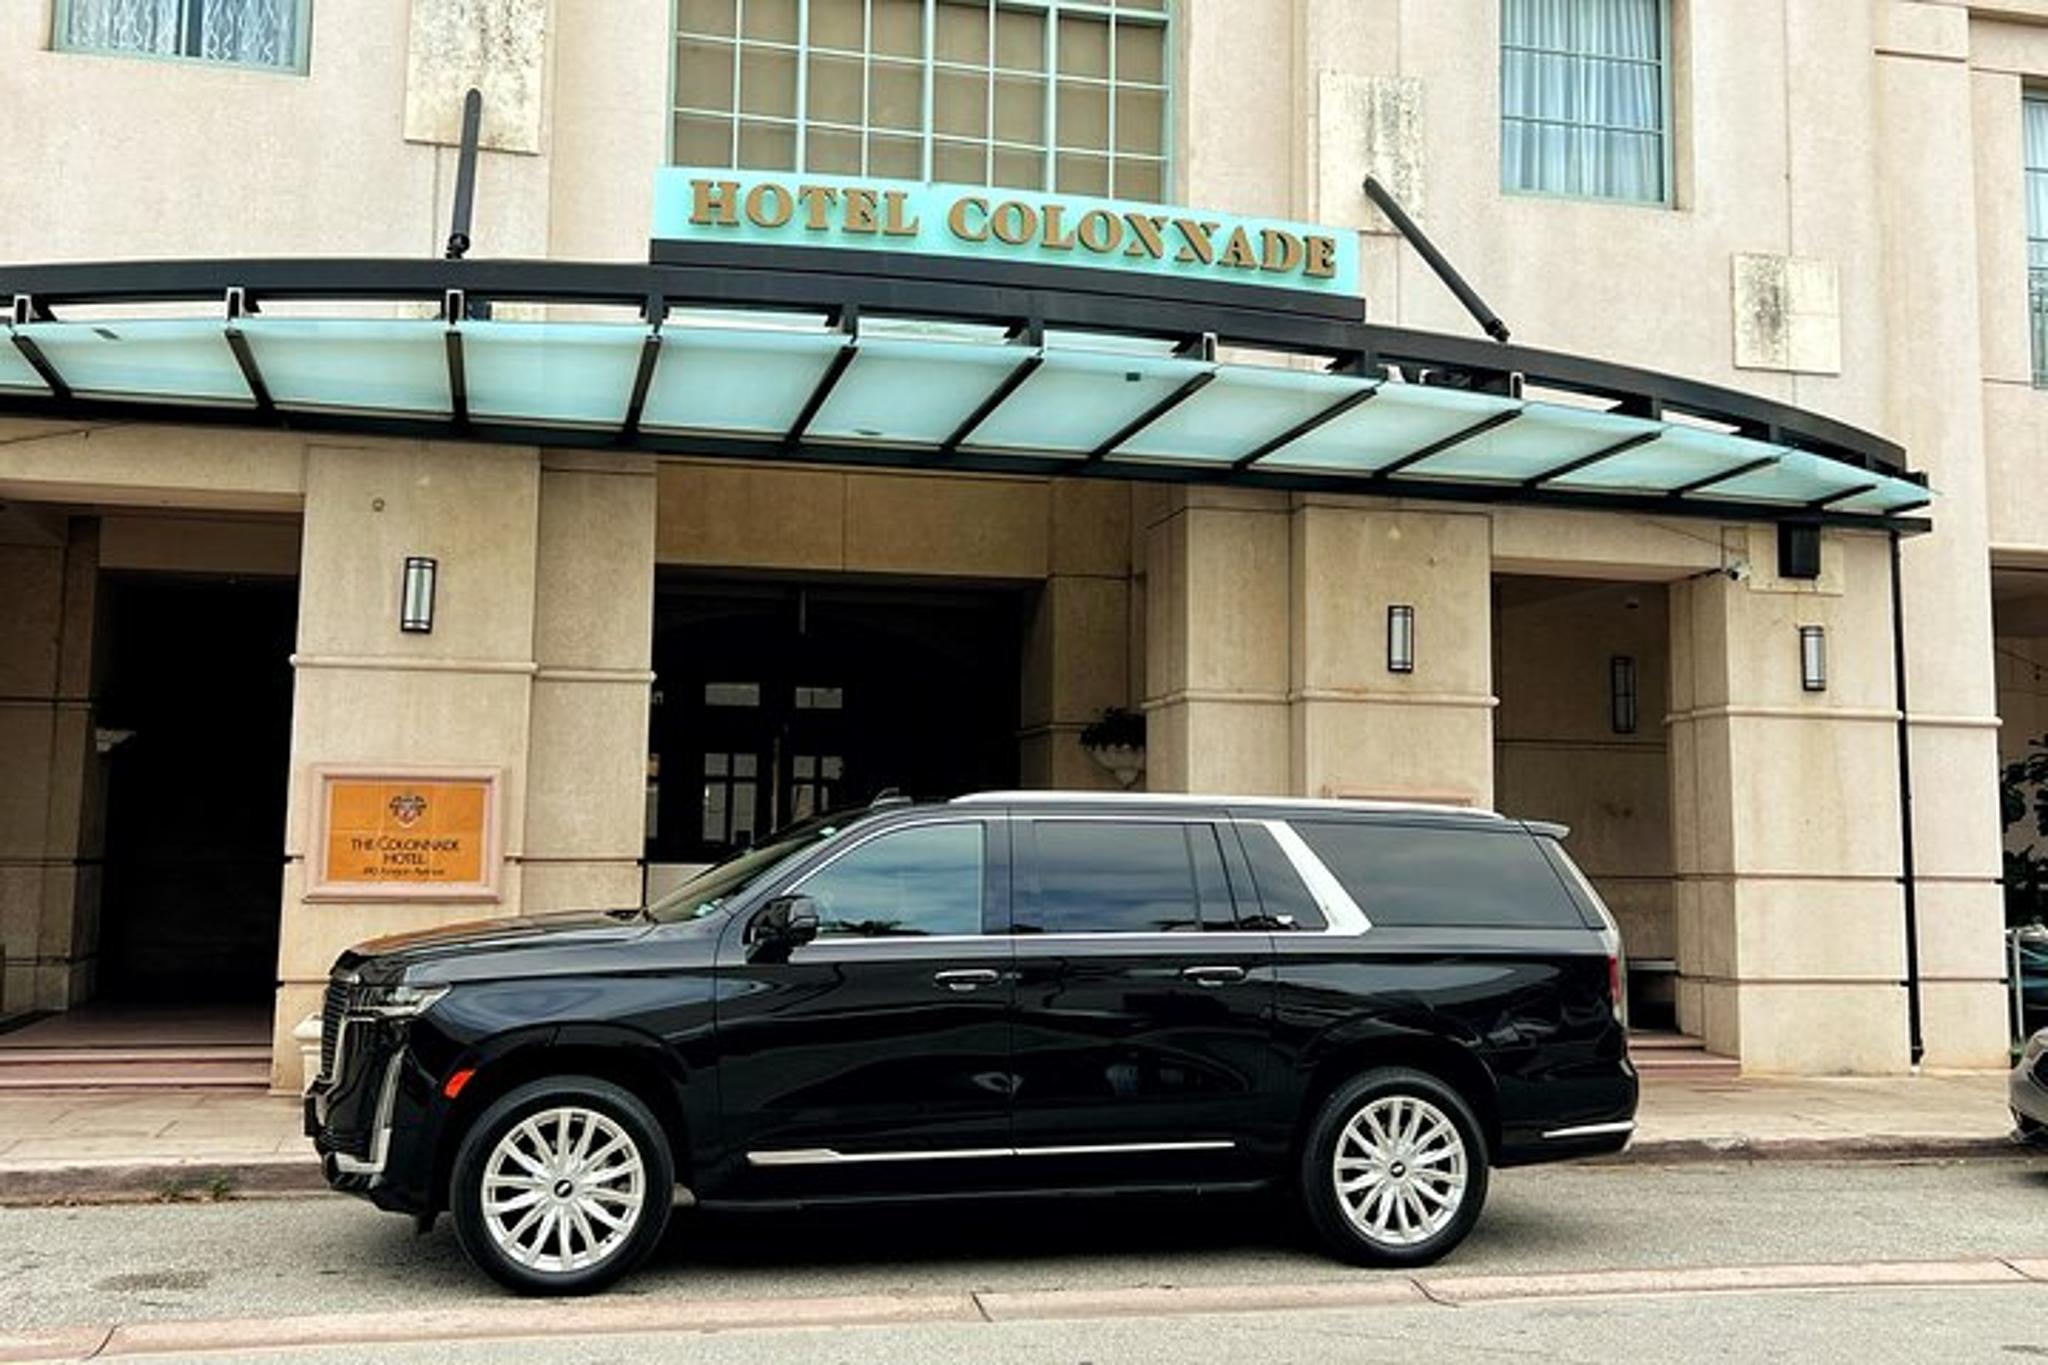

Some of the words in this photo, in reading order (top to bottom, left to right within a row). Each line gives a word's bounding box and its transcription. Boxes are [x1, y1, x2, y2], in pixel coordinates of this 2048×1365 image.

[688, 180, 919, 236] HOTEL
[947, 197, 1336, 279] COLONNADE
[352, 838, 374, 851] THE
[383, 853, 426, 865] HOTEL
